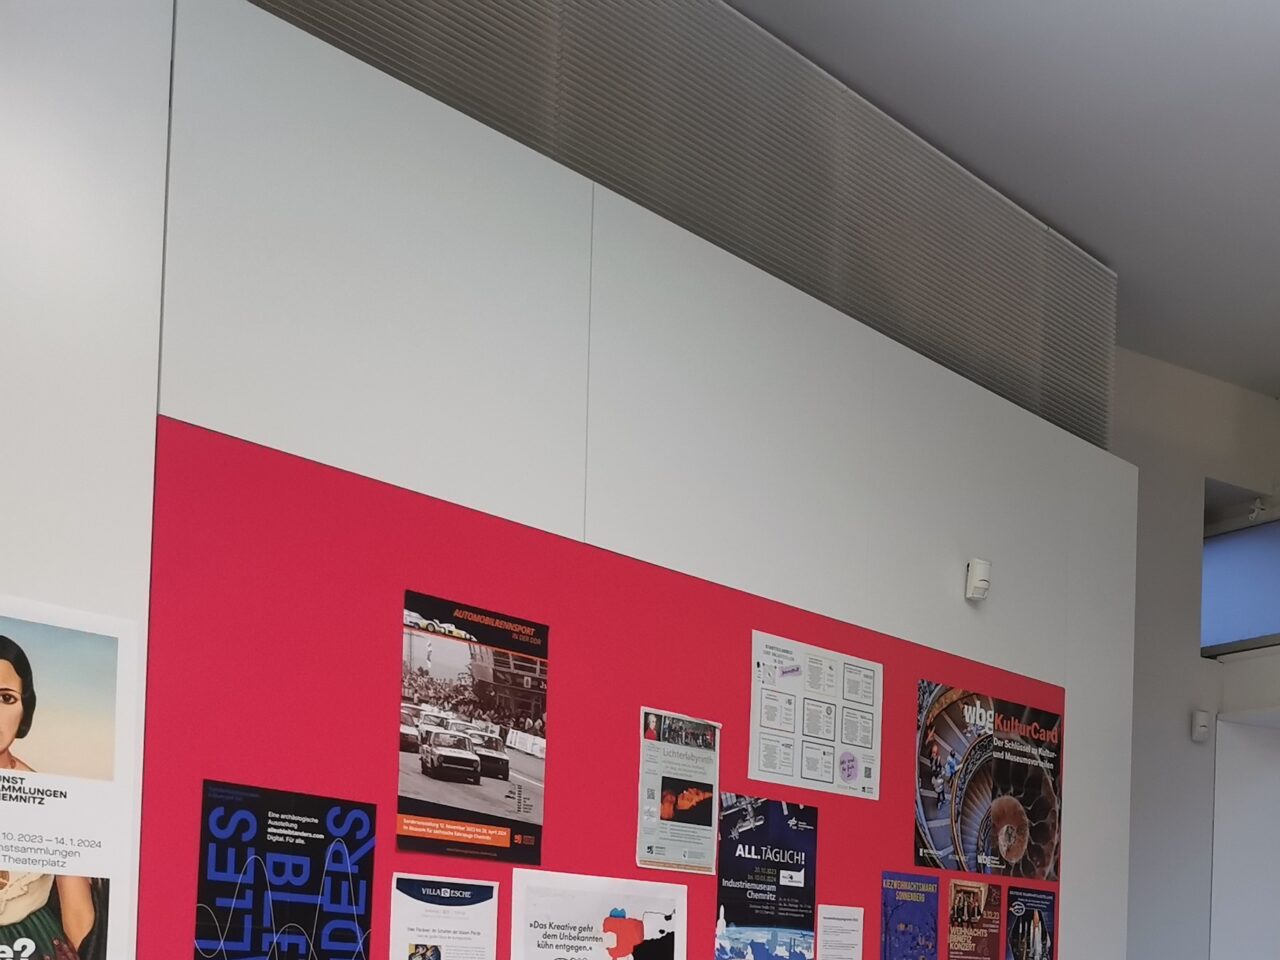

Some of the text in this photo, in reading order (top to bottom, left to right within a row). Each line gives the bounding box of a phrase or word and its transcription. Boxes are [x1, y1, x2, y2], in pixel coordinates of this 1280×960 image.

[963, 700, 994, 735] wbg
[993, 737, 1003, 747] Der
[993, 751, 1004, 760] und
[2, 854, 67, 868] Theaterplatz
[422, 887, 472, 898] VILLA ESCHE
[746, 889, 776, 901] Chemnitz
[548, 922, 577, 932] Kreative
[577, 924, 594, 934] geht
[542, 930, 604, 943] dem Unbekannten
[536, 940, 554, 949] kühn
